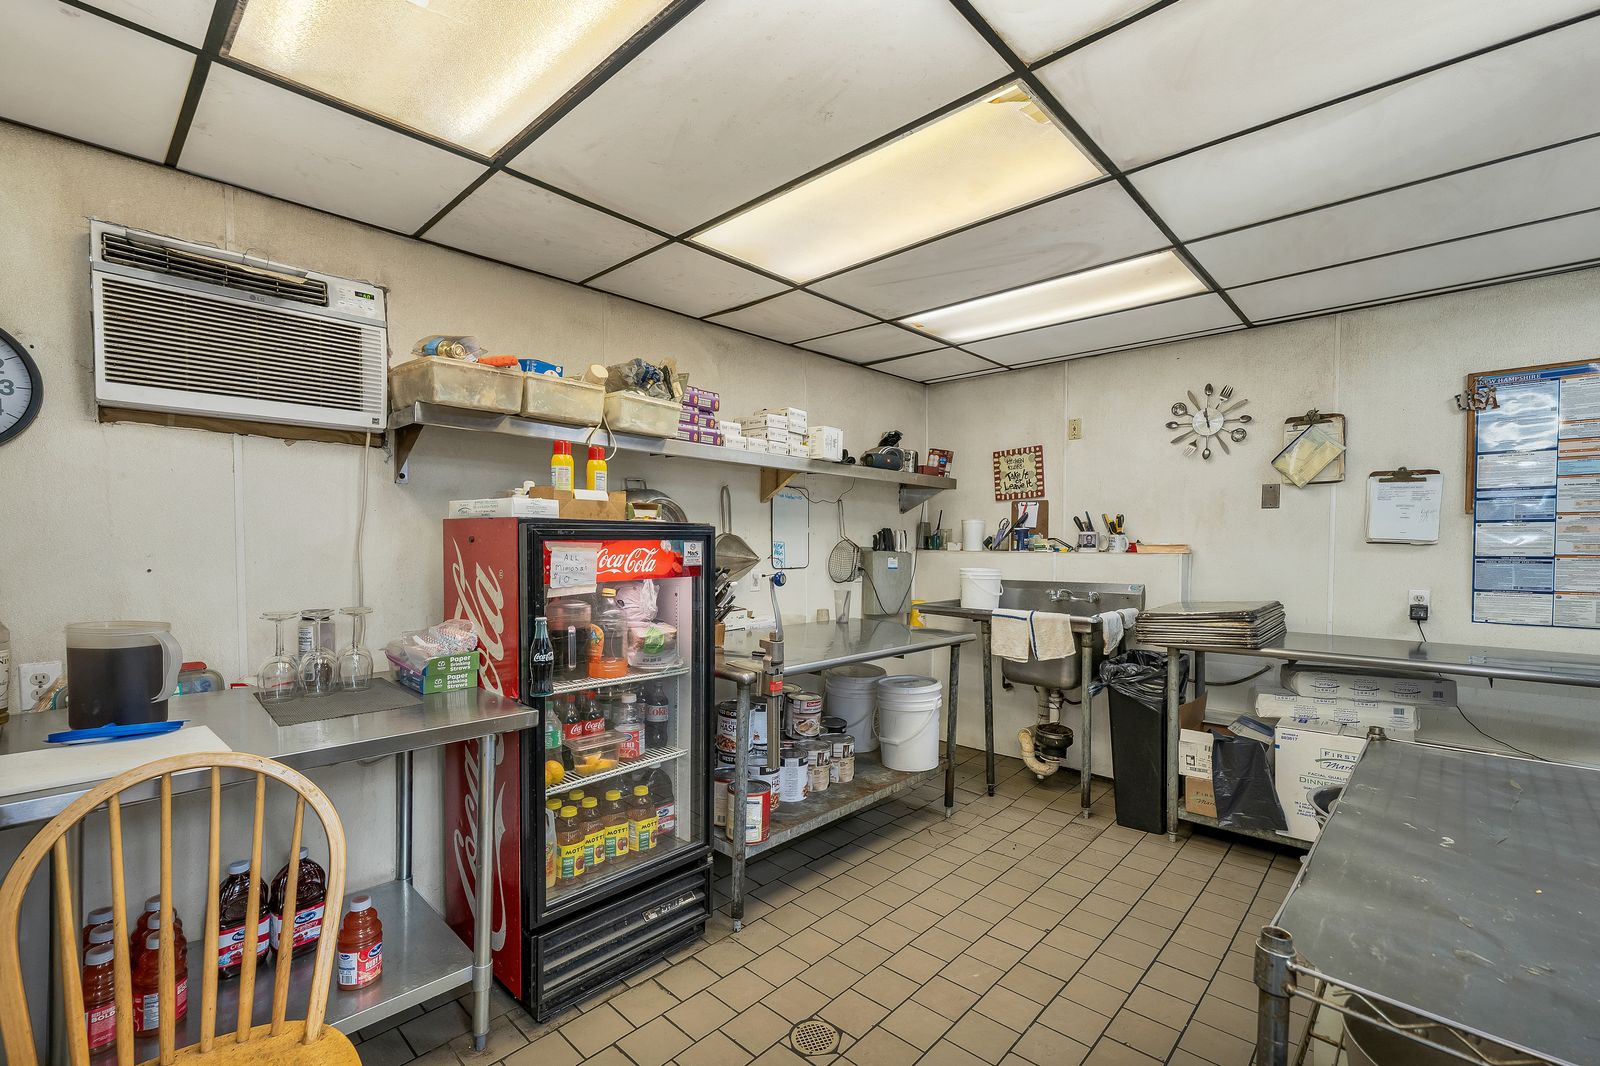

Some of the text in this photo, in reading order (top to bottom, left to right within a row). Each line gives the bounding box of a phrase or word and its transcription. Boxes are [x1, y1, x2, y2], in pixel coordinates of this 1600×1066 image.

[1497, 374, 1541, 383] HAMPSHIRE
[0, 378, 14, 396] 3
[1004, 469, 1029, 481] Take It
[1003, 478, 1034, 491] Leave It
[563, 553, 579, 561] ALL
[449, 655, 471, 663] Paper
[447, 673, 469, 681] Paper
[1324, 751, 1357, 761] FIRST
[1323, 761, 1355, 771] Mark
[1299, 776, 1336, 786] DINNE
[91, 1010, 116, 1023] BOLD
